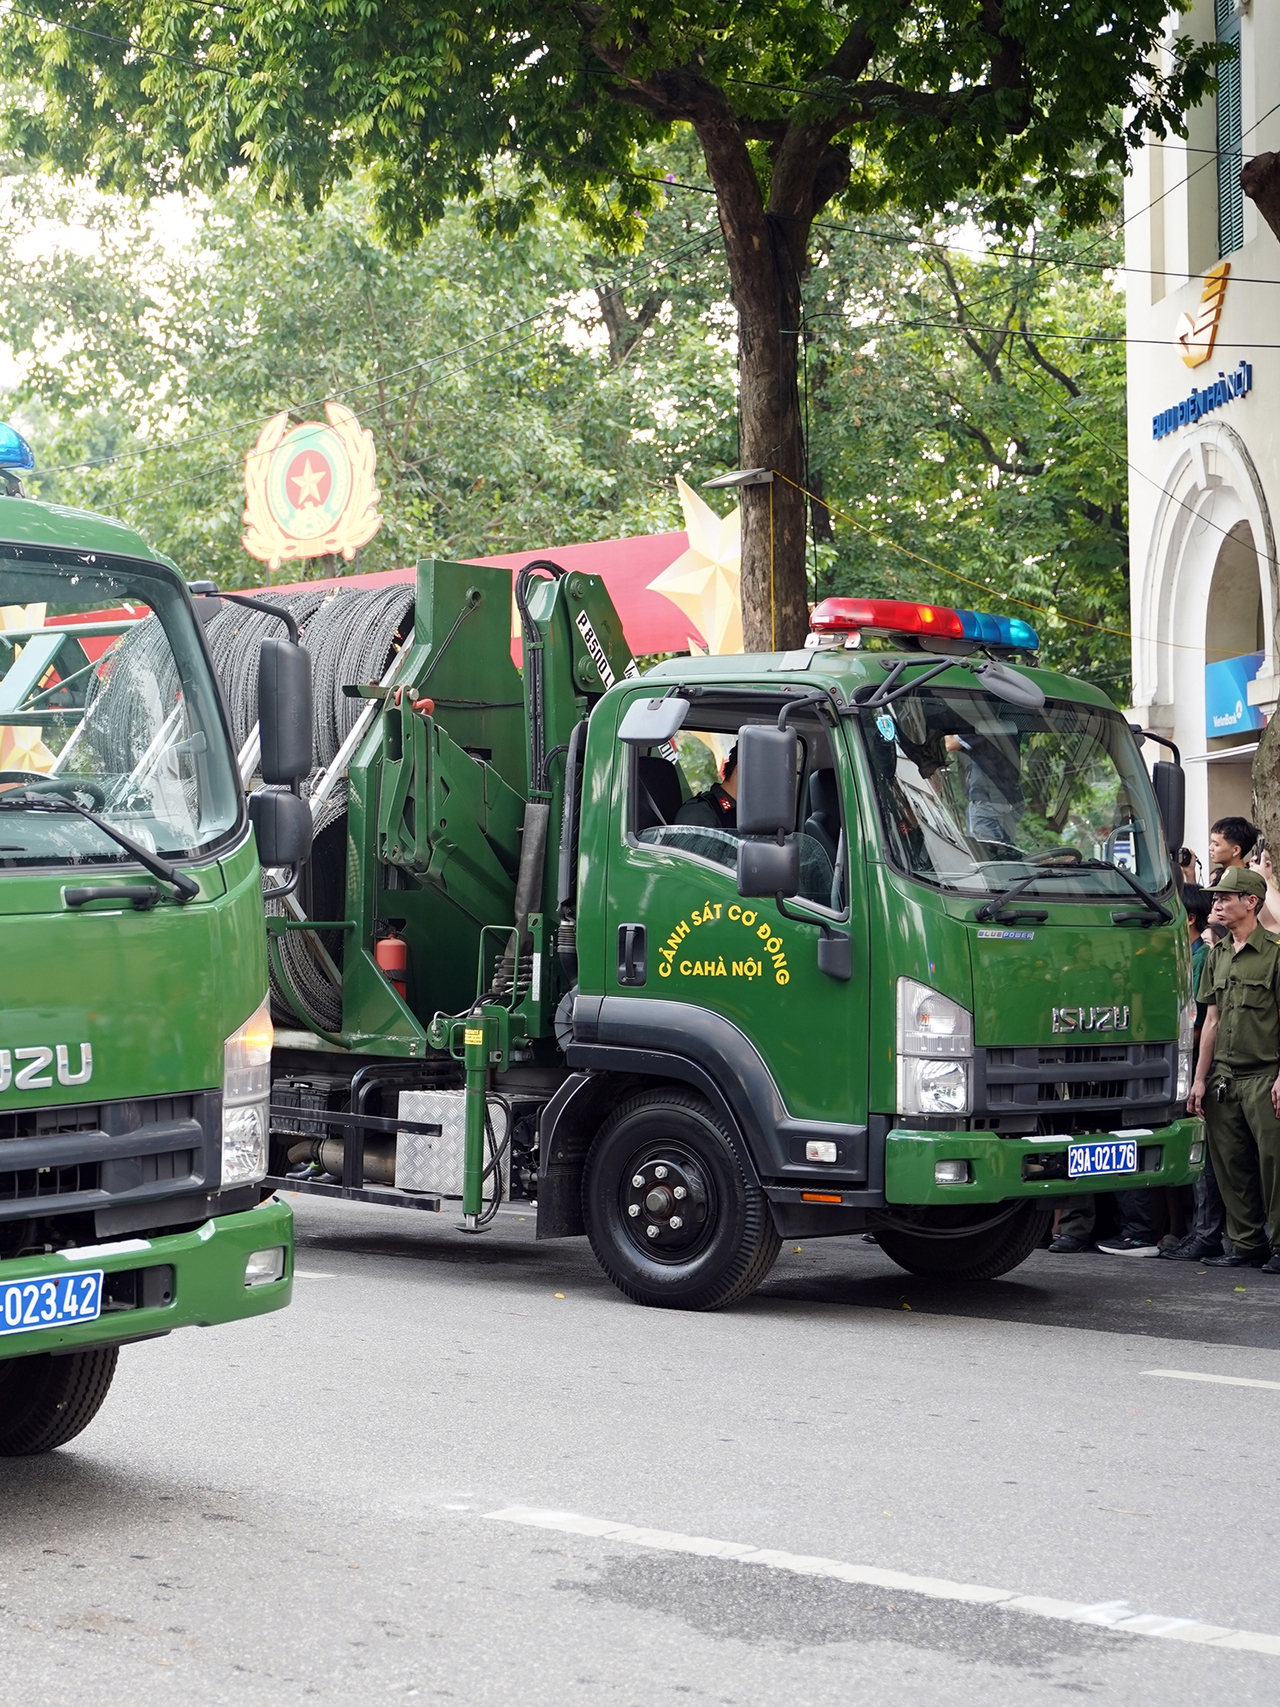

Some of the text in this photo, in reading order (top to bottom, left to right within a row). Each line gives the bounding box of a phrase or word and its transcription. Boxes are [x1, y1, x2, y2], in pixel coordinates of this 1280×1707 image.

[658, 900, 790, 986] CẢNH SÁT CƠ ĐỘNG
[731, 957, 762, 981] NỘI
[1052, 1005, 1130, 1034] ISUZU
[1070, 1144, 1135, 1173] 29A-021.76
